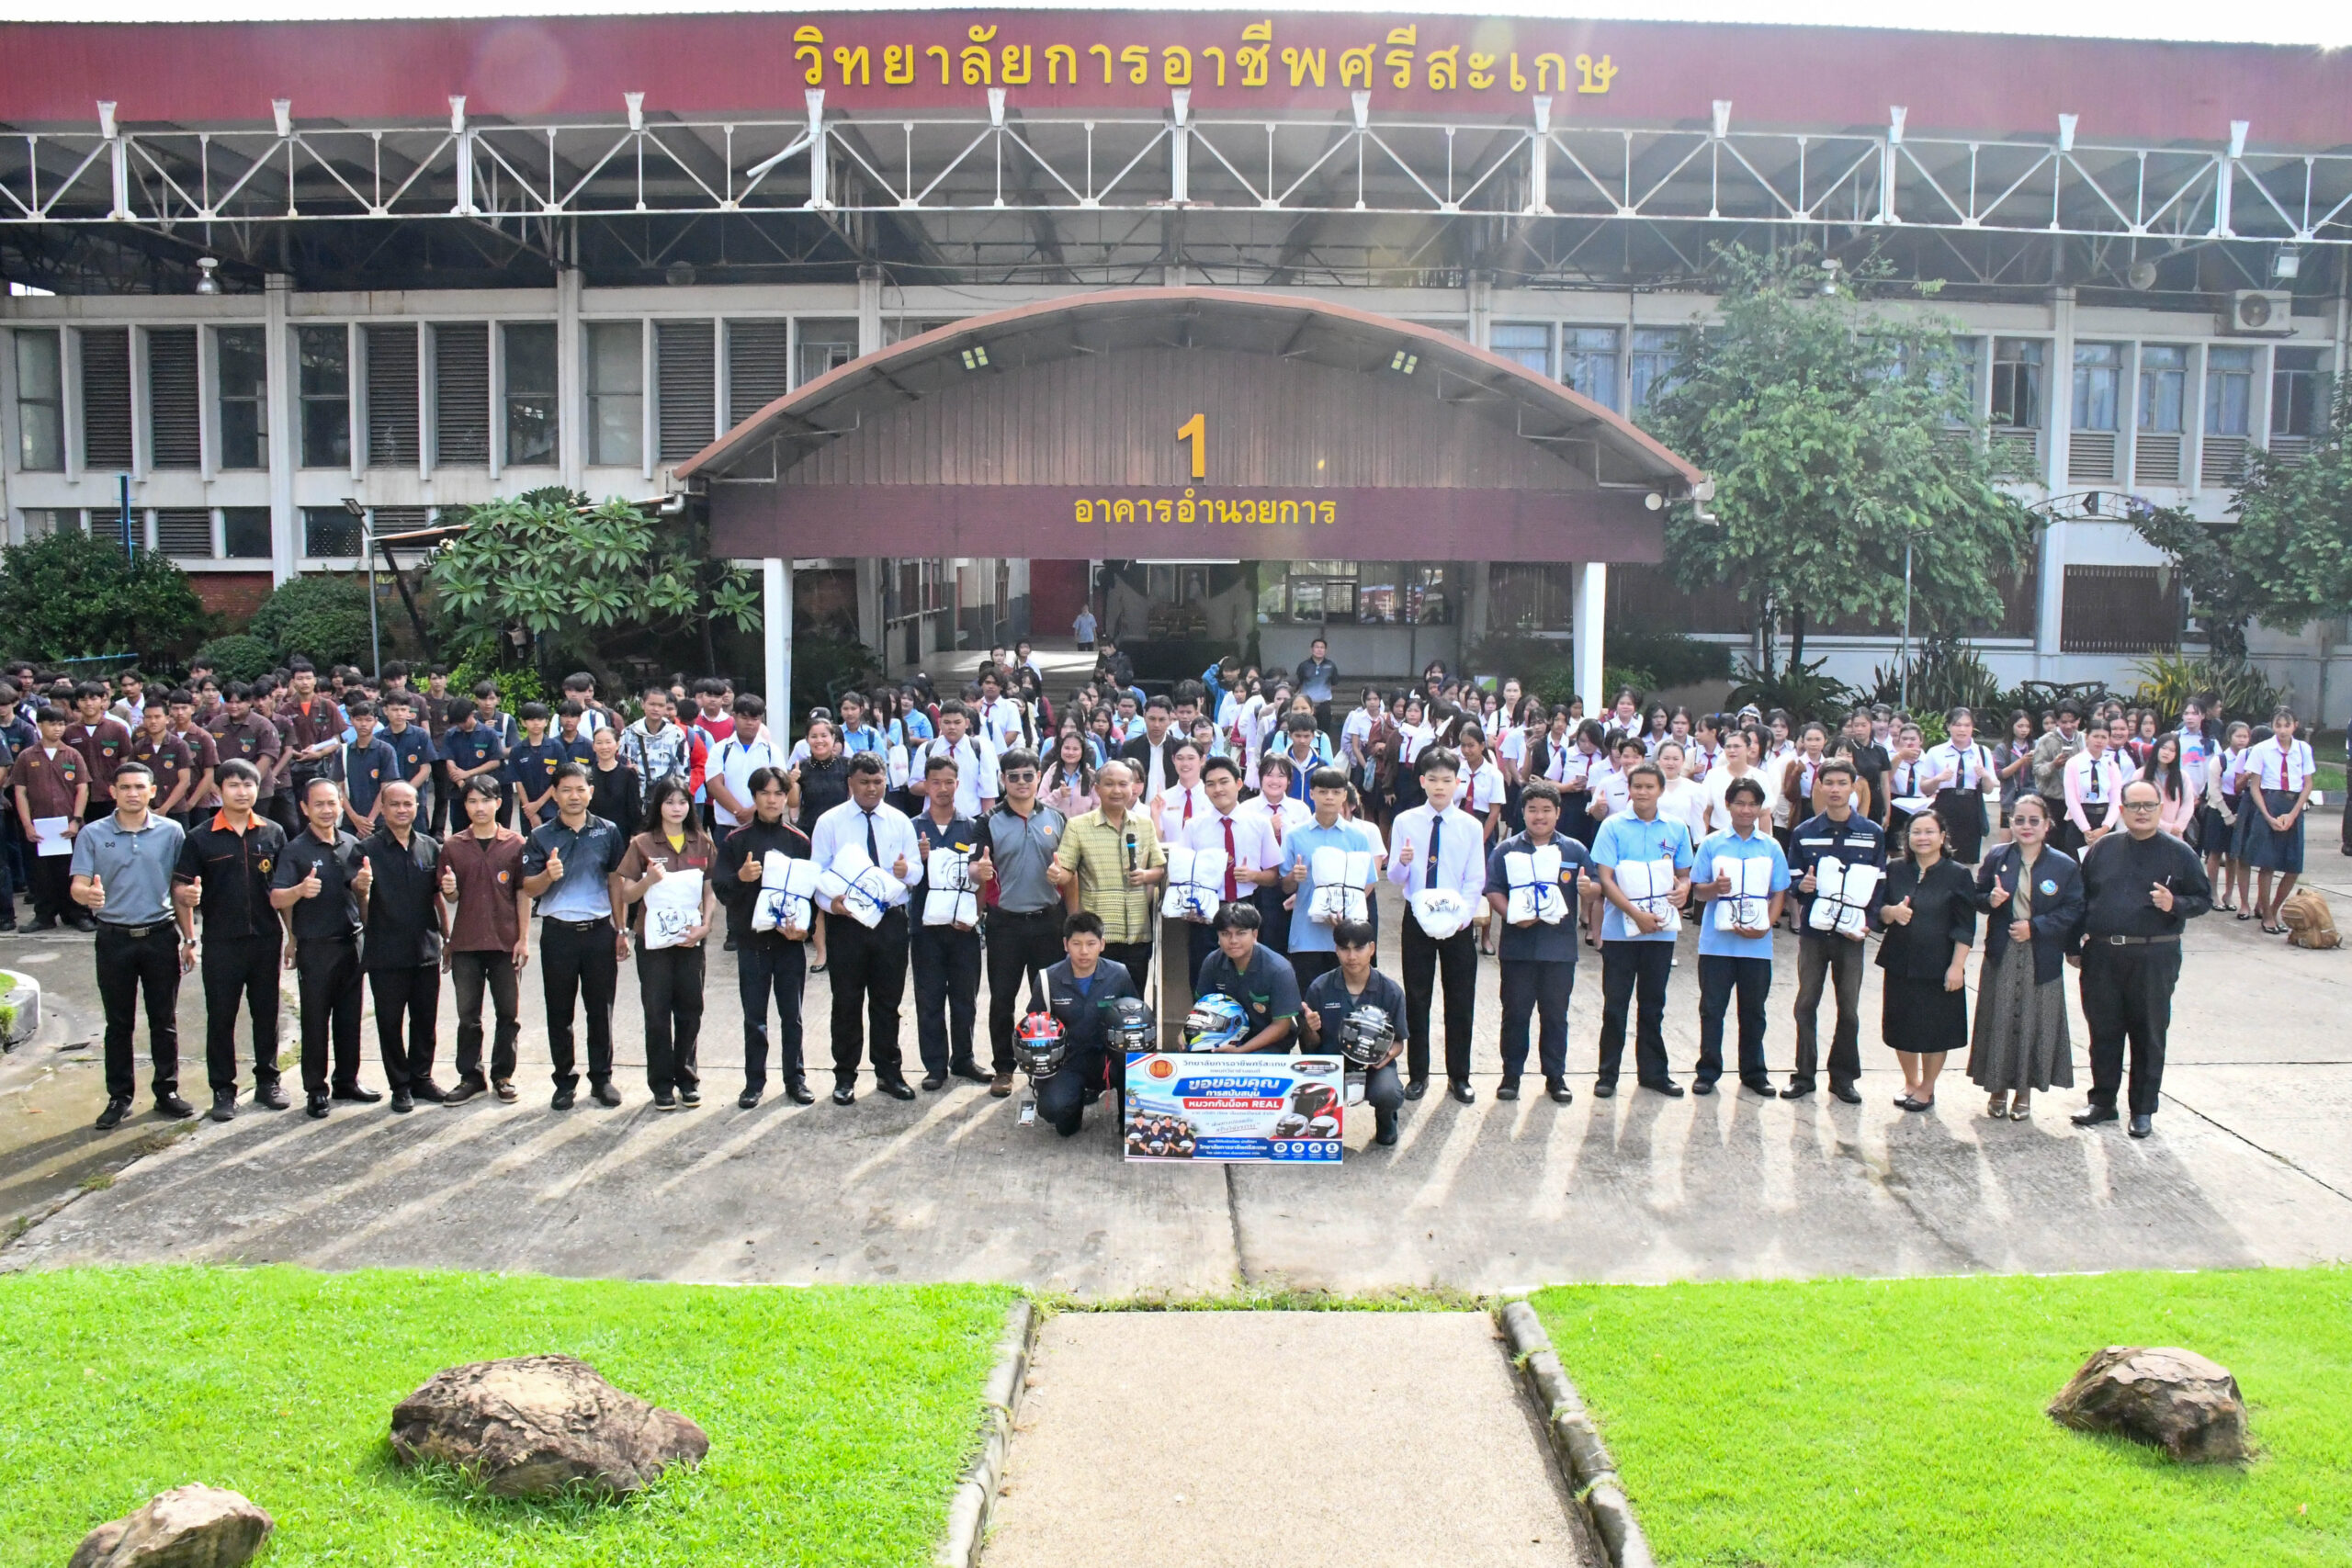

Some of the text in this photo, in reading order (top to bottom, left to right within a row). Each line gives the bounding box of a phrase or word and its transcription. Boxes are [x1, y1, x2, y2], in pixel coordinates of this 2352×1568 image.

[794, 20, 1619, 93] วิทยาลัยการอาชีพศรีสะเกษ
[1177, 413, 1204, 478] 1
[1074, 488, 1337, 524] อาคารอำนวยการ
[1189, 1078, 1280, 1091] ขอขอบคุณ
